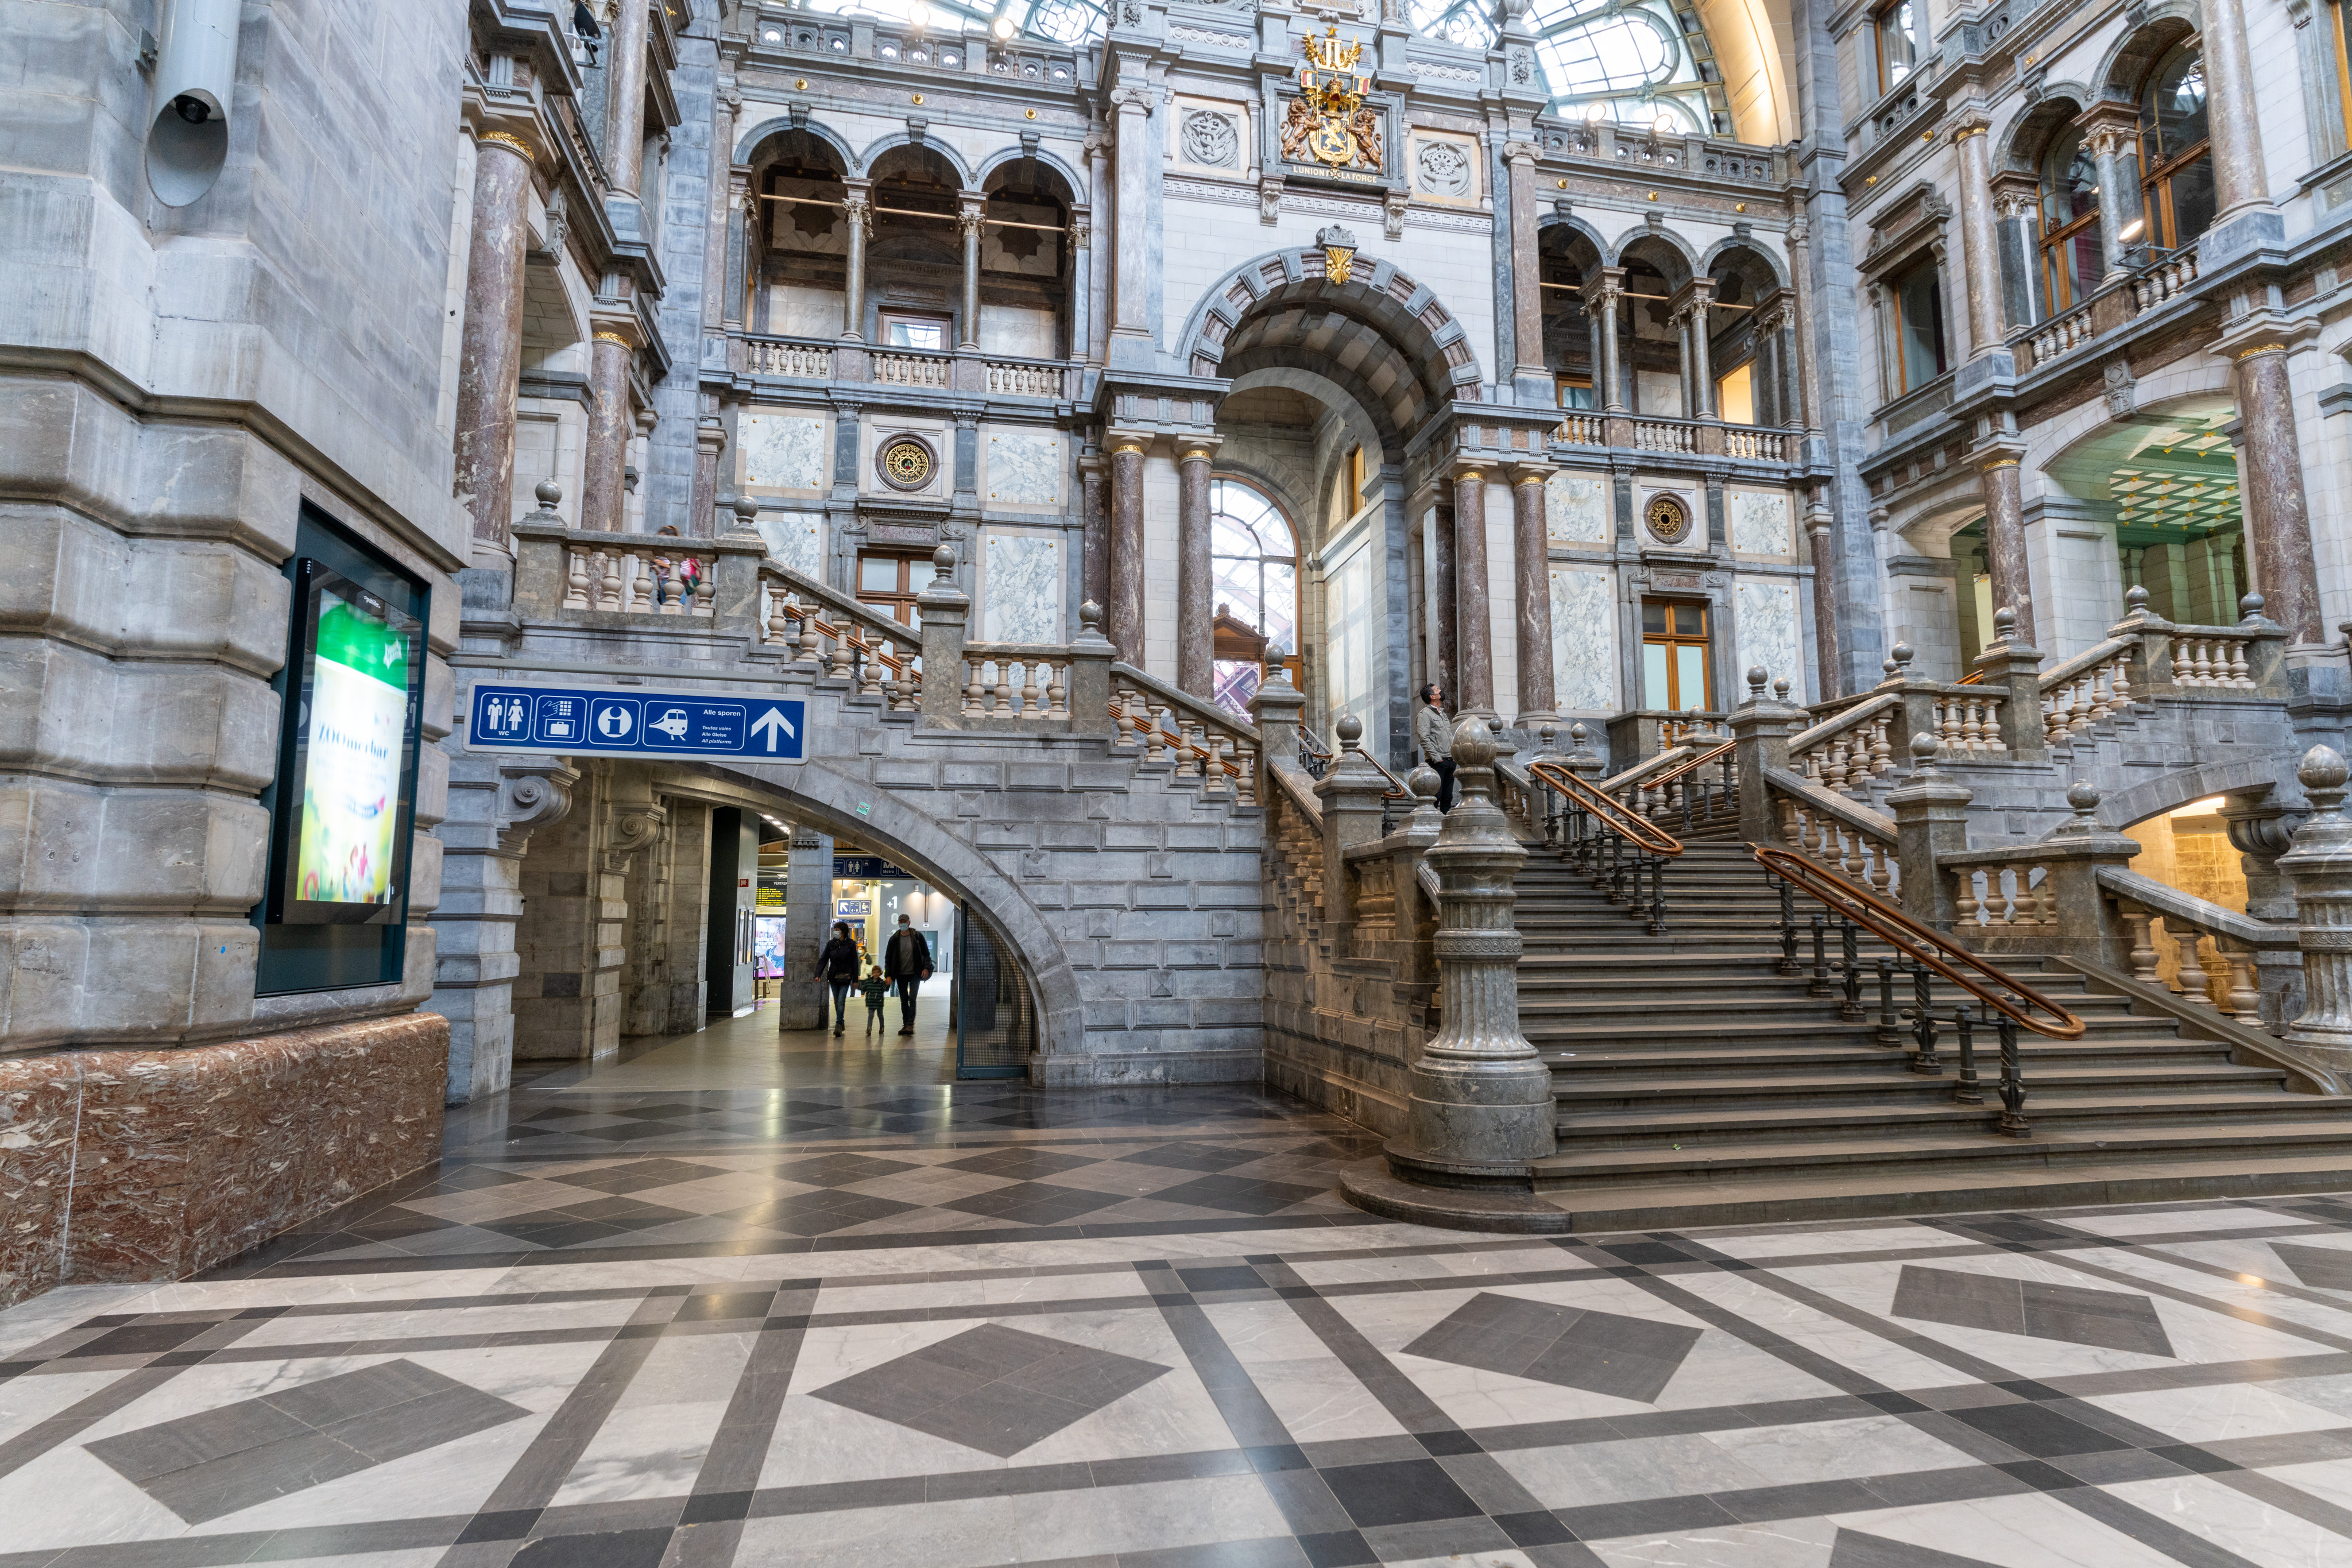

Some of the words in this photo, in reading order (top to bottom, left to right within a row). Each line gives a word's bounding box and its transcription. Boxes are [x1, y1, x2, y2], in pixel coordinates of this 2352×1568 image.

[1293, 165, 1325, 177] L'UNION
[1352, 173, 1377, 183] FORCE
[887, 896, 898, 909] +1
[891, 912, 899, 925] 0
